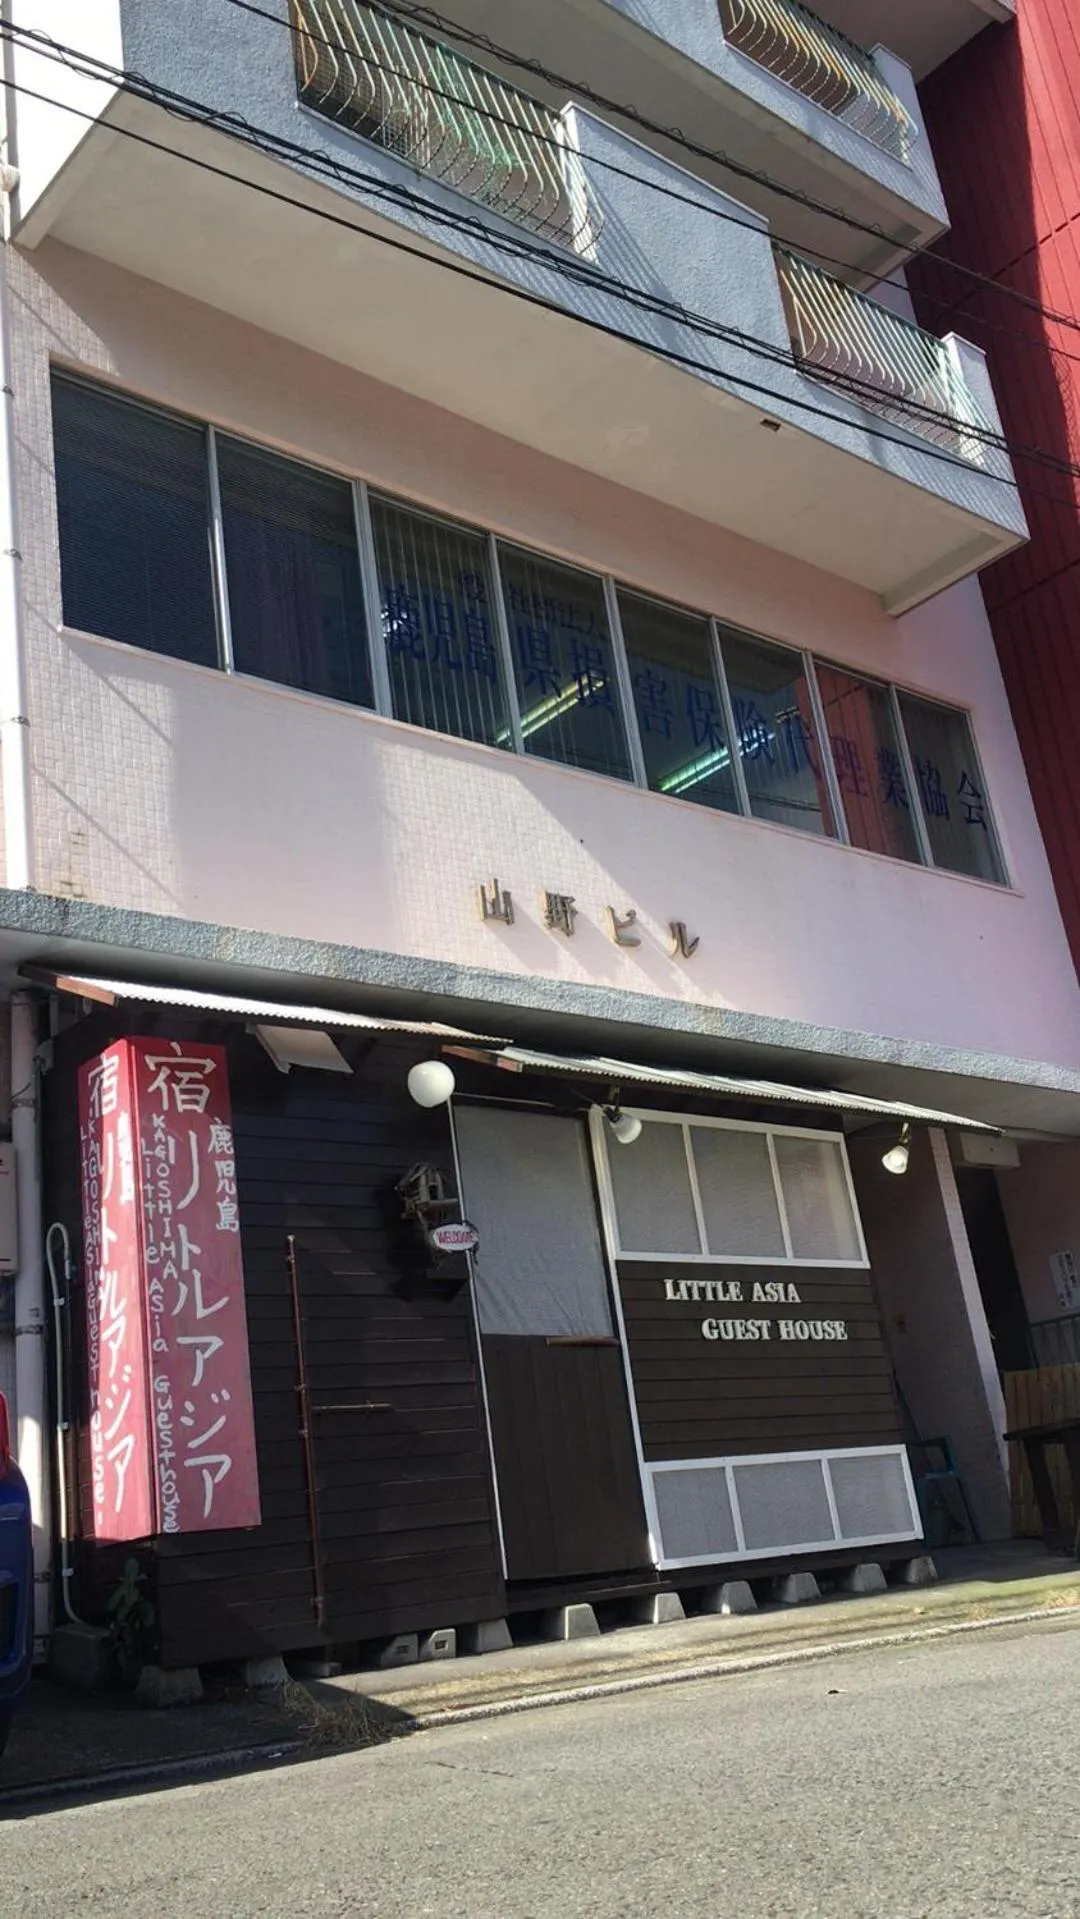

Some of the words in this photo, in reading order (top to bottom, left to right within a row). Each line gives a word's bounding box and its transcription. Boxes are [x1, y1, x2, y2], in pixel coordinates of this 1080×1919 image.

[475, 877, 700, 959] 山野ビル
[151, 1112, 179, 1280] KAGOSHIMA
[207, 1117, 240, 1233] 鹿児島
[88, 1053, 135, 1513] 宿リトルアジア
[144, 1042, 232, 1518] 宿リトルアジア
[437, 1230, 478, 1245] WELCOME
[664, 1279, 743, 1301] LITTLE
[752, 1281, 801, 1303] ASIA
[702, 1318, 772, 1341] GUEST
[777, 1320, 848, 1341] HOUSE
